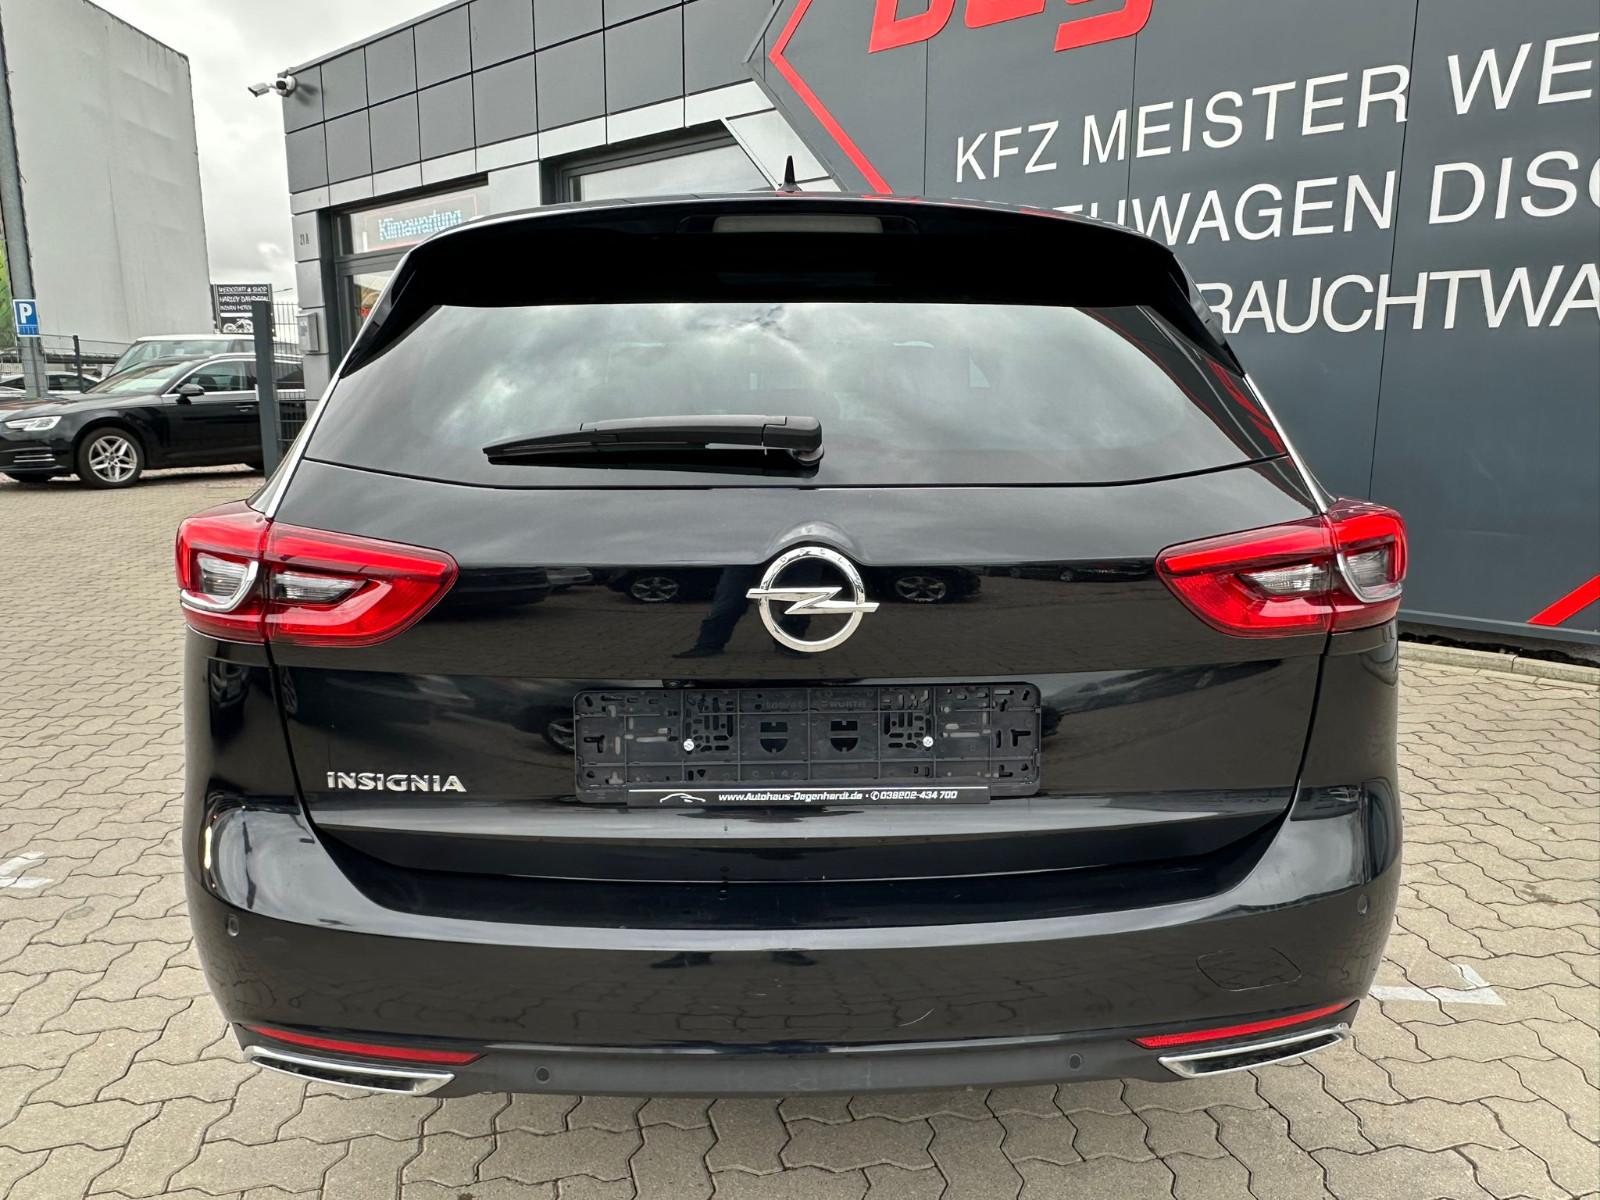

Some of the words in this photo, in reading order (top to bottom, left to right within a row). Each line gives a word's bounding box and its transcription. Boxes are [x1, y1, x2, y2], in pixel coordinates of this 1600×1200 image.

[955, 120, 1059, 183] KFZ
[1081, 63, 1408, 166] MEISTER
[1447, 32, 1600, 115] WE
[1052, 170, 1396, 246] WAGEN
[1428, 150, 1600, 225] DIS
[18, 303, 33, 324] P
[326, 771, 467, 793] INSIGNIA
[718, 791, 863, 803] www.Autohaus-Degenhardt.de
[939, 790, 958, 800] 700
